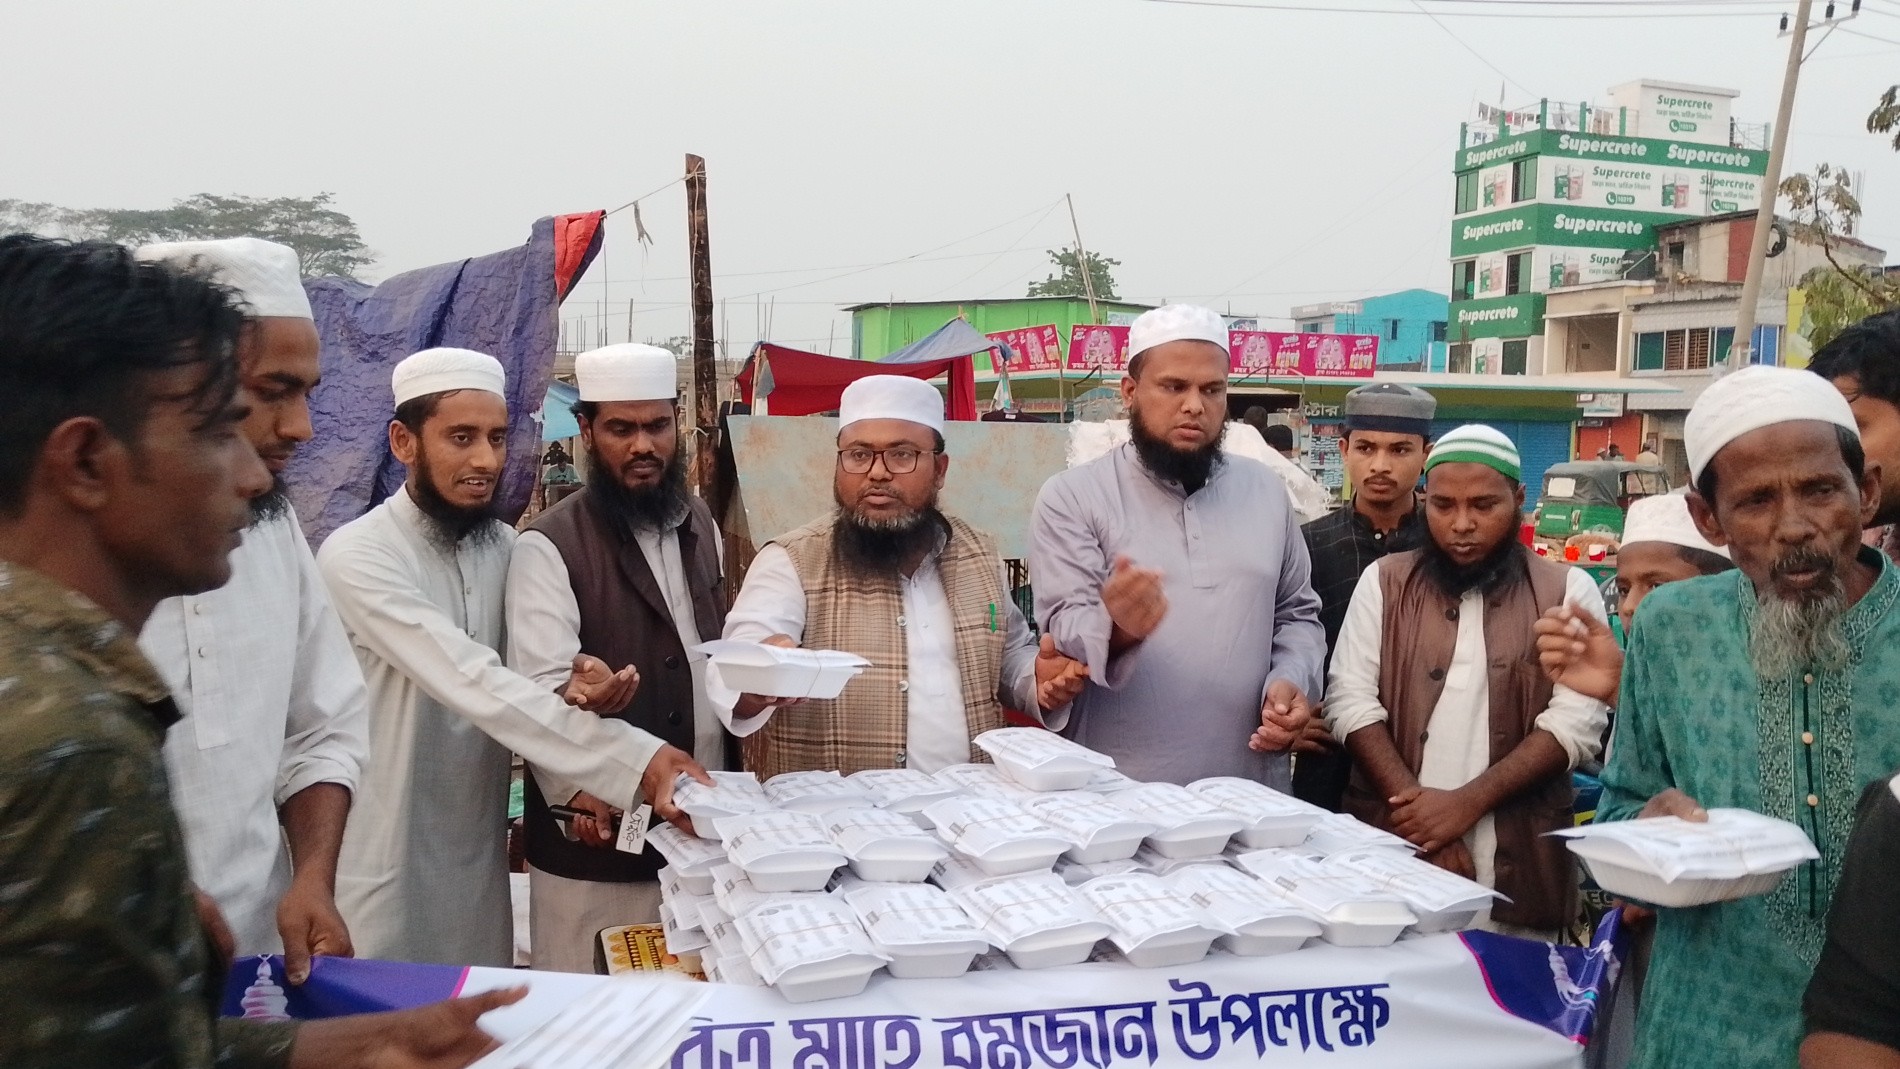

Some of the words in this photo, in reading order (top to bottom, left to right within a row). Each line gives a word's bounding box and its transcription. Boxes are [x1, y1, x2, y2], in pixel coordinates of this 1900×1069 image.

[1656, 94, 1714, 110] Supercrete
[1465, 140, 1527, 166] Supercrete
[1558, 134, 1647, 156] Supercrete
[1667, 143, 1750, 167] Supercrete
[1592, 165, 1652, 180] Supercrete
[1462, 218, 1524, 241] Supercrete
[1553, 213, 1643, 235] Supercrete
[1589, 253, 1621, 266] Super
[1458, 306, 1519, 325] Supercrete
[1168, 978, 1390, 1060] উপলক্ষে
